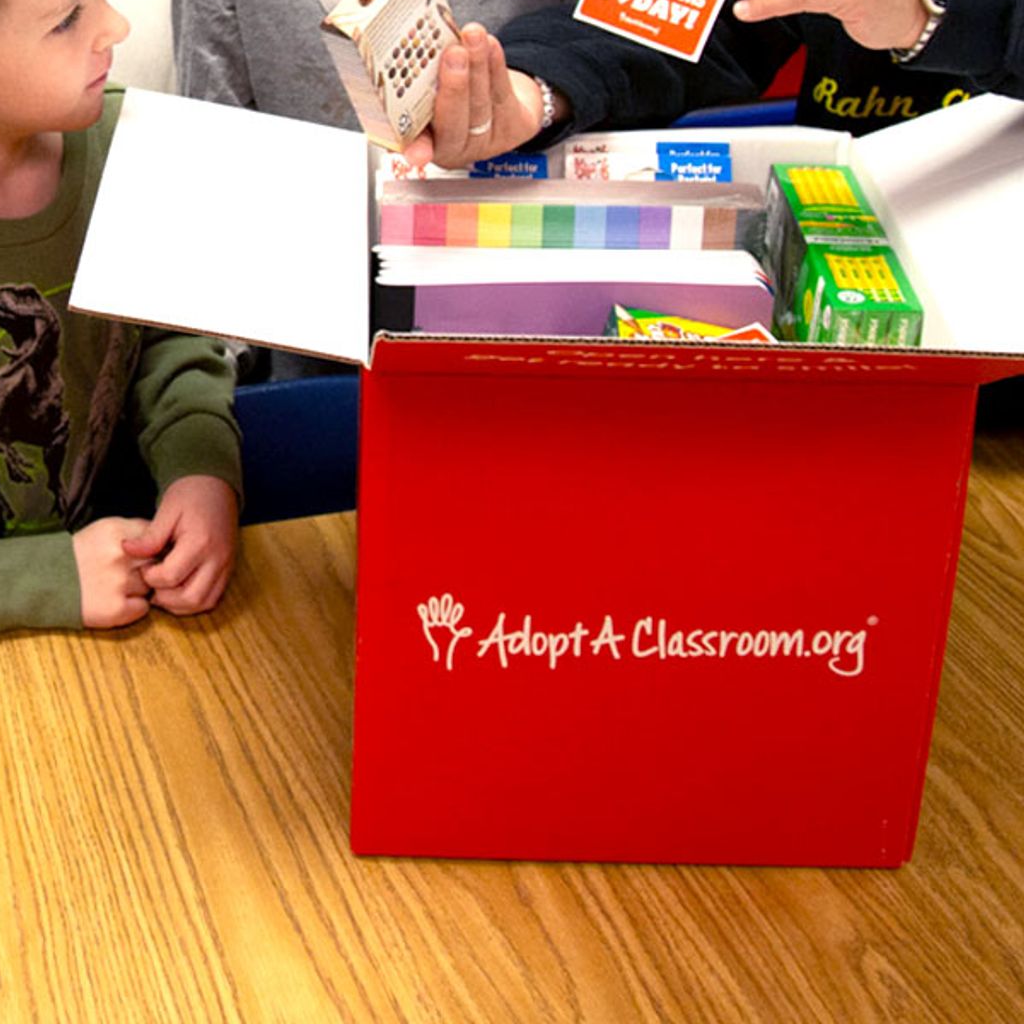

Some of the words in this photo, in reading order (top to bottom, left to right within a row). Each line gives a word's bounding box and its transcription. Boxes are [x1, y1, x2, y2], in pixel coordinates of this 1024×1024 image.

[813, 77, 920, 119] Rahn
[670, 162, 705, 175] Perfect
[706, 163, 723, 175] for
[477, 612, 590, 669] Adopt
[589, 615, 625, 659] A
[631, 617, 867, 677] Classroom.org
